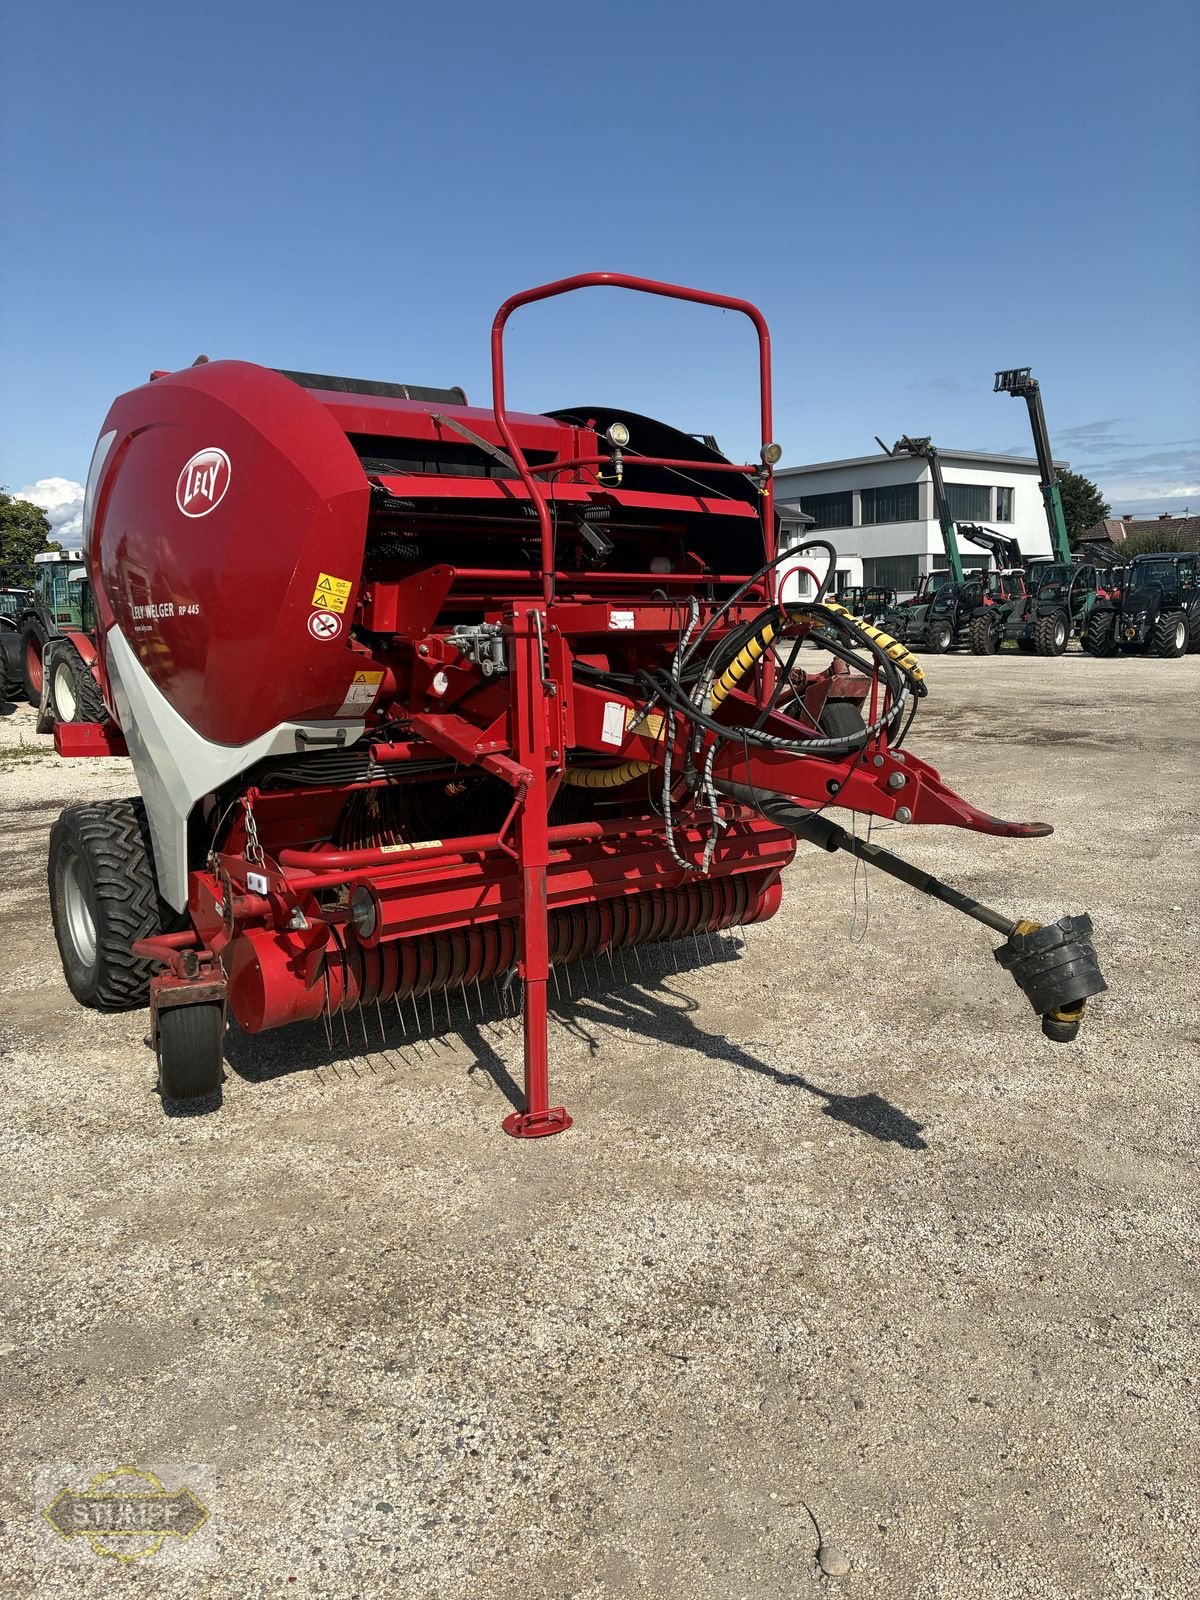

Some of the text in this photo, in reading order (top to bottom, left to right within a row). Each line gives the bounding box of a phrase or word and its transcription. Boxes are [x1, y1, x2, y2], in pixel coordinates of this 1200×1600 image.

[184, 459, 222, 507] LELY
[131, 602, 200, 619] LELY WELGER RP 445
